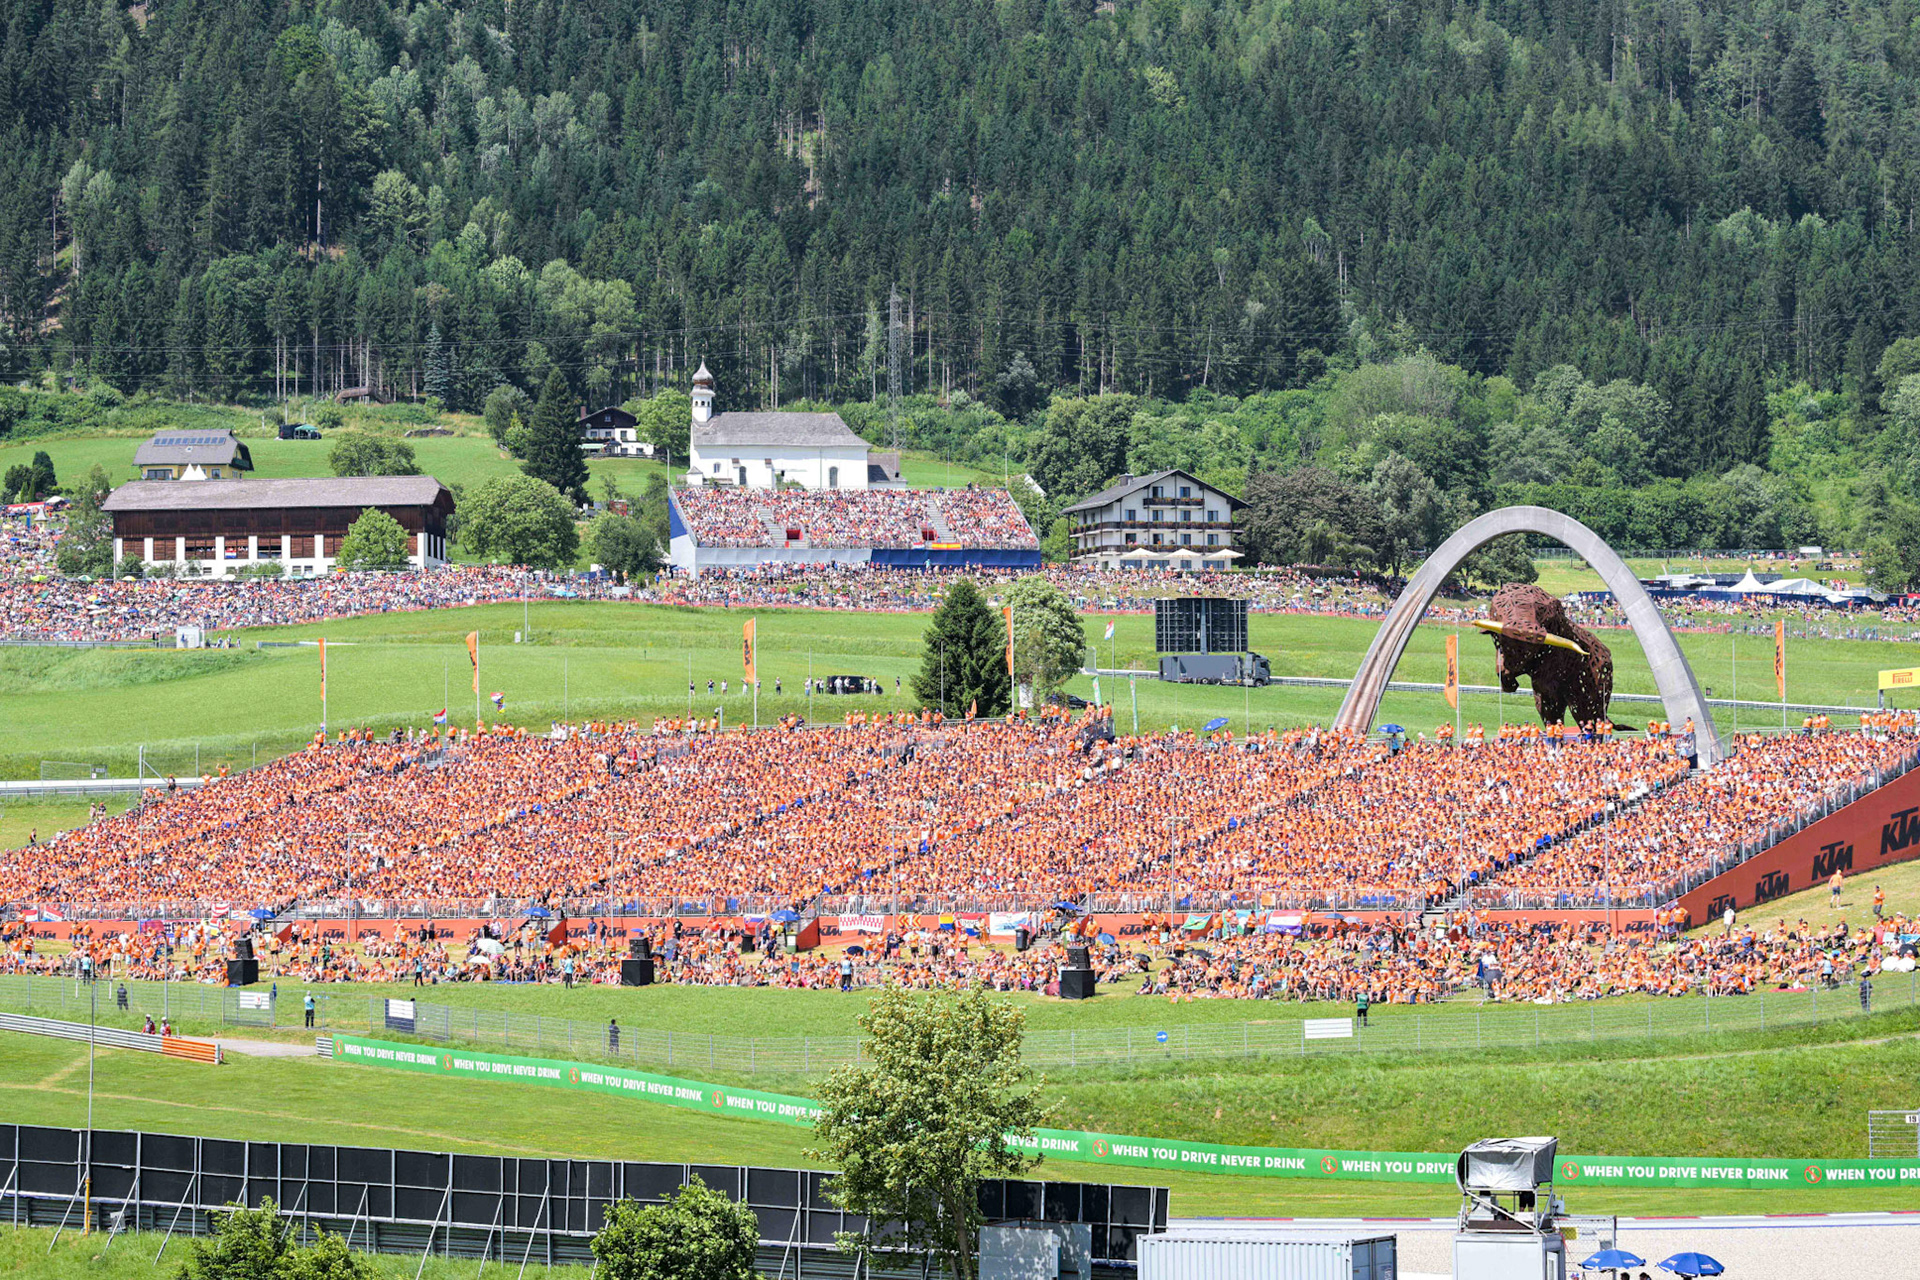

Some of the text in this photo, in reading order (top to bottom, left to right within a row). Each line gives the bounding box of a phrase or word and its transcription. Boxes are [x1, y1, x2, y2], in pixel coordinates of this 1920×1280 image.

[1892, 672, 1913, 684] PIRELLI
[1812, 841, 1853, 881] KTM
[1755, 870, 1789, 902] KTM
[322, 928, 345, 939] KTM
[819, 925, 842, 936] KTM
[1309, 922, 1328, 934] TM
[1625, 921, 1655, 932] KTM
[36, 930, 56, 939] KTM
[344, 1043, 436, 1065] WHEN YOU DRIVE NEVER DRINK
[454, 1058, 560, 1079] WHEN YOU DRIVE NEVER DRINK
[581, 1071, 702, 1101] WHEN YOU DRIVE NEVER DRINK
[726, 1095, 754, 1110] WHEN
[756, 1100, 776, 1113] YOU
[778, 1103, 806, 1117] DRIVE
[1003, 1134, 1079, 1152] NEVER DRINK
[1112, 1144, 1305, 1170] WHEN YOU DRIVE NEVER DRINK
[1342, 1160, 1454, 1174] WHEN YOU DRIVE
[1583, 1165, 1789, 1180] WHEN YOU DRIVE NEVER DRINK
[1825, 1168, 1865, 1180] WHEN
[1868, 1168, 1896, 1180] YOU
